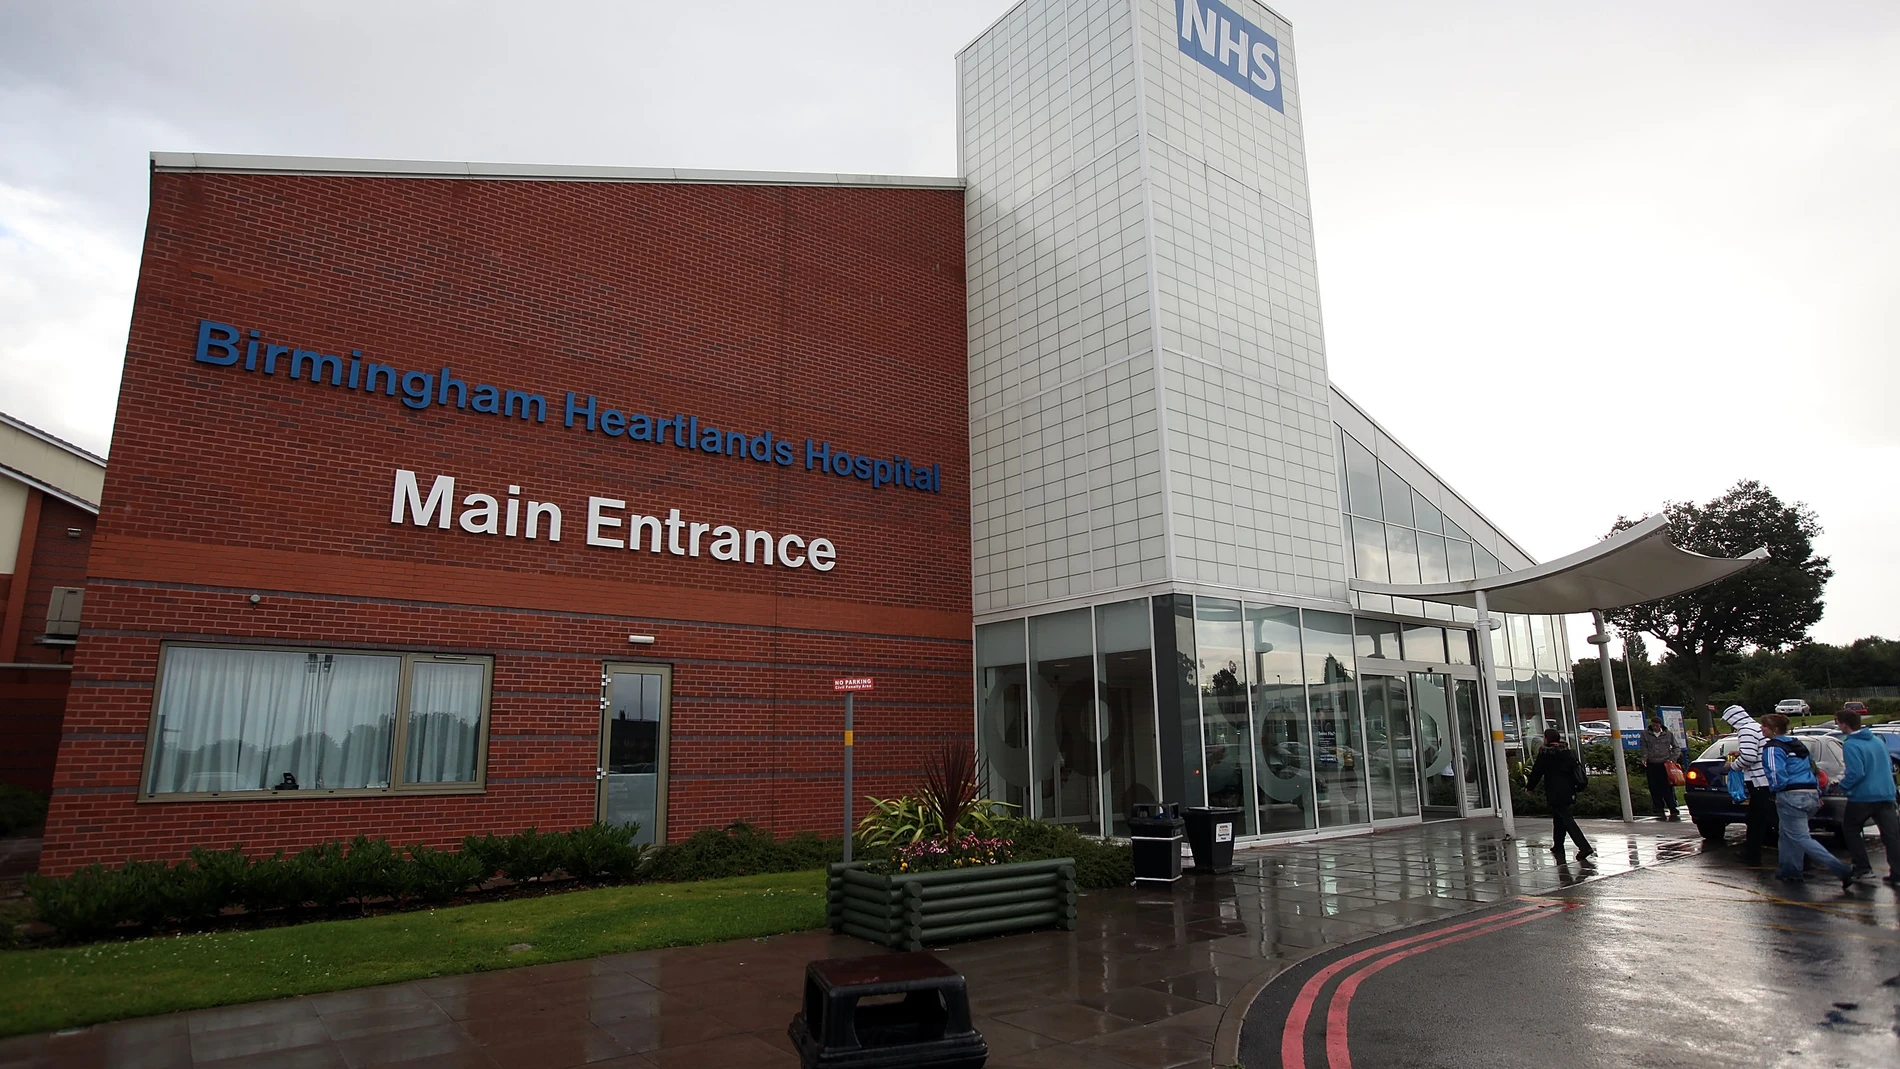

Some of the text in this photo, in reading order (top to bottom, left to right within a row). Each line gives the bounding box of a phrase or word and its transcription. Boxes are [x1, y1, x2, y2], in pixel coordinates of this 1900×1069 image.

[1181, 0, 1276, 92] NHS
[195, 319, 941, 493] Birmingham Heartlands Hospital
[391, 468, 837, 573] Main Entrance
